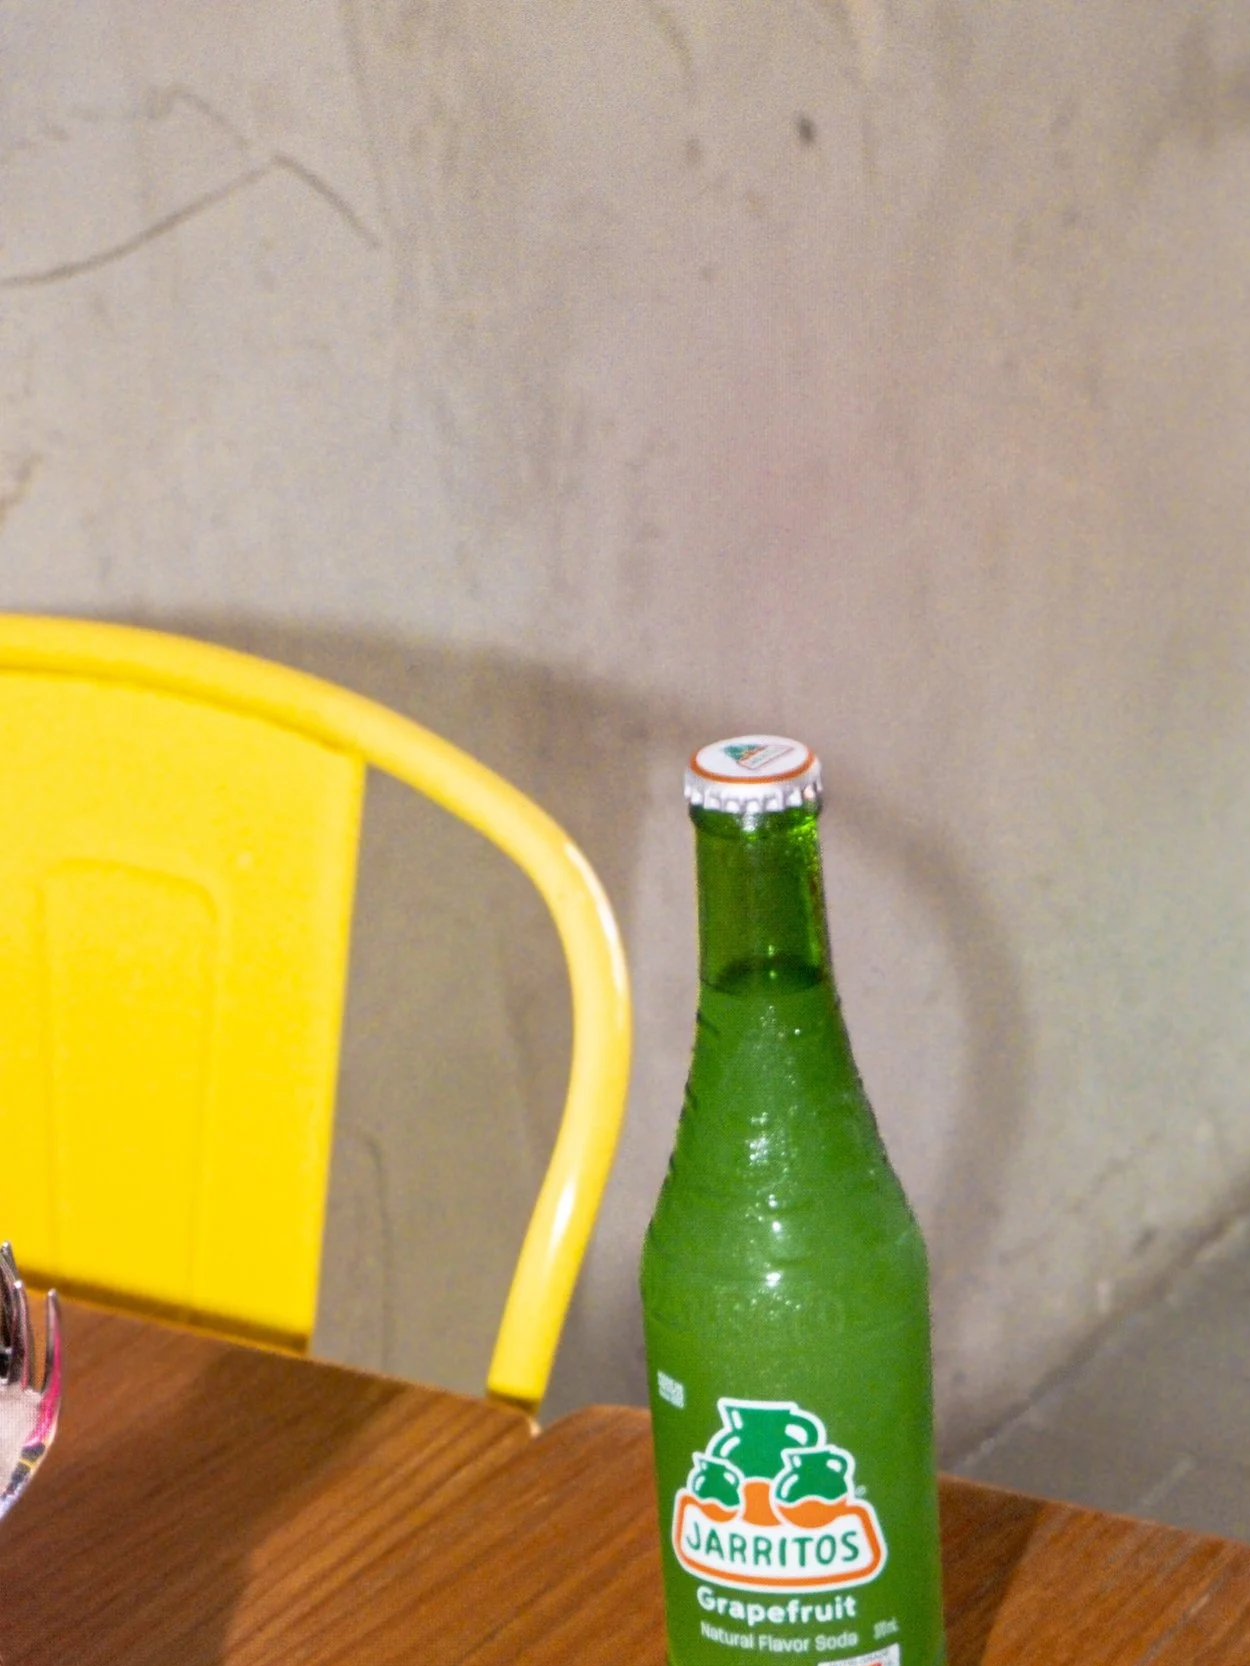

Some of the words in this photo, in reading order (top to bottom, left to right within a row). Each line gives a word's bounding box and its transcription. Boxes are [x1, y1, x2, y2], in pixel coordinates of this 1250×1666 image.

[685, 1521, 861, 1568] JARRITOS
[697, 1586, 857, 1626] Grapefruit
[701, 1620, 754, 1649] Natural
[759, 1634, 809, 1653] Flavor
[815, 1632, 858, 1651] Soda
